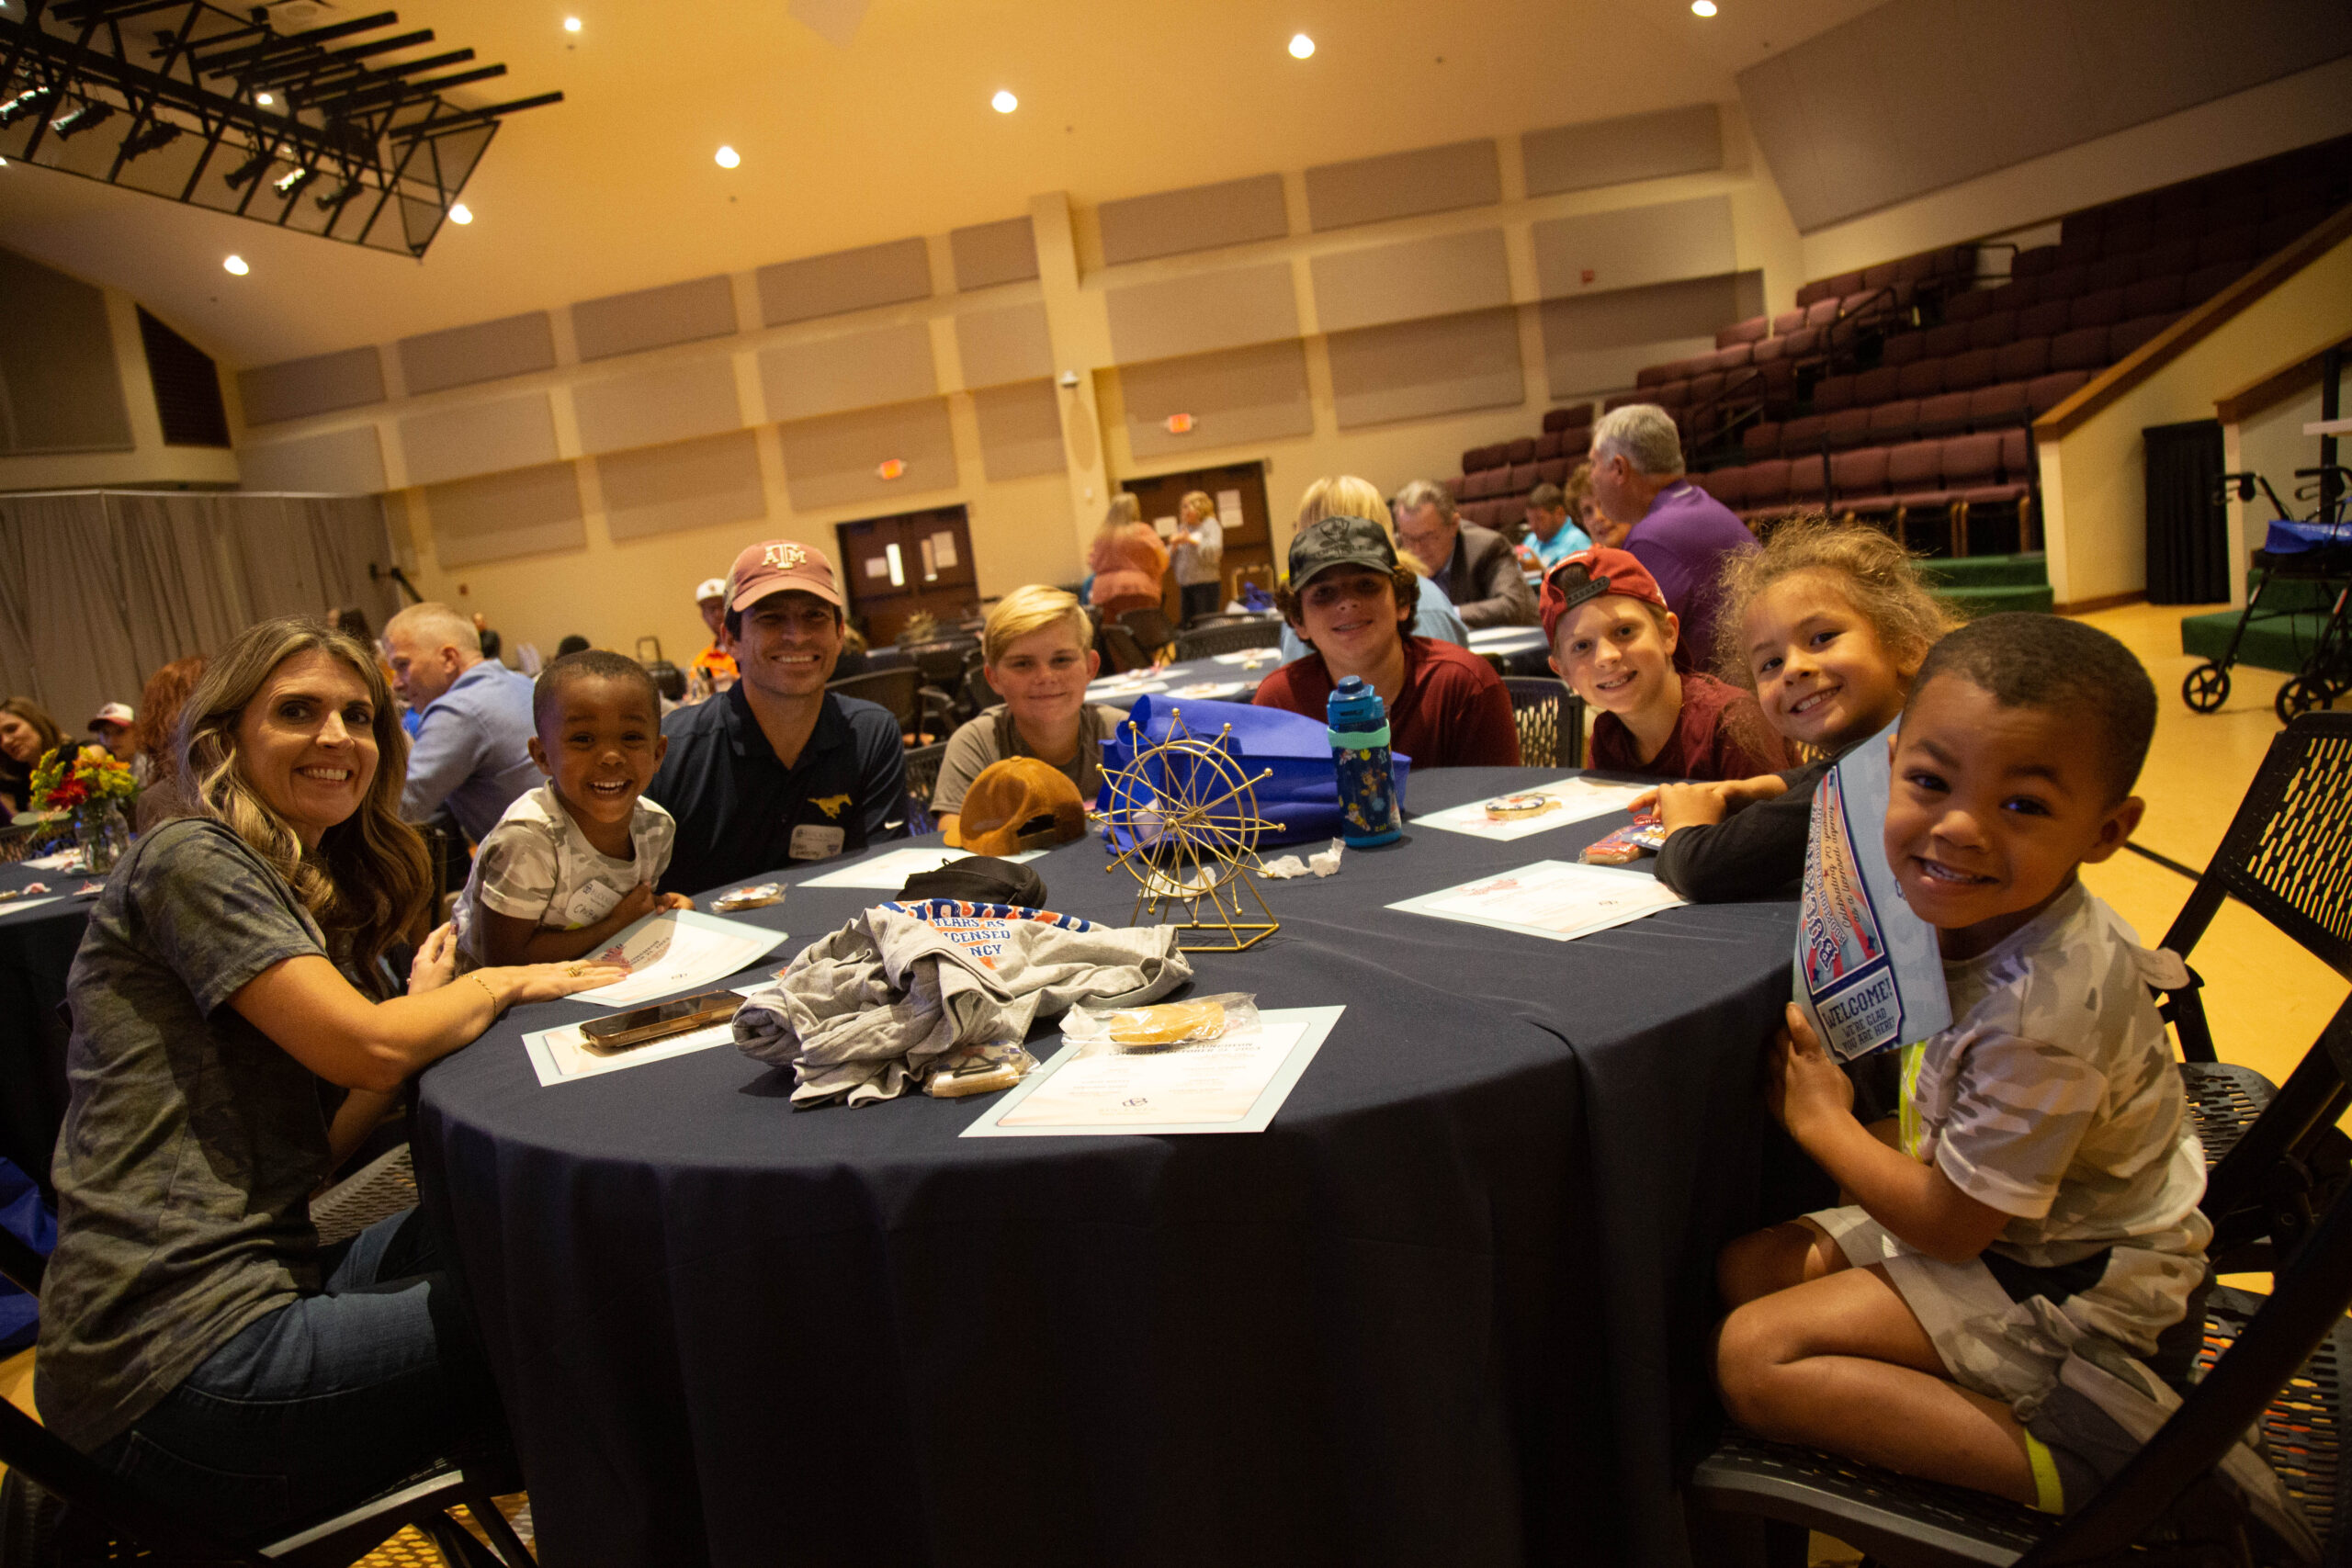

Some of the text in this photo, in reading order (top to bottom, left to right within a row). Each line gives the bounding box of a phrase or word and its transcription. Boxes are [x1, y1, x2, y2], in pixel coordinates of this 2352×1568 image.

[1833, 847, 1849, 892] licensed
[1820, 890, 1847, 945] ADOPTION
[1829, 864, 1852, 928] Celebrating
[933, 918, 1005, 928] YEARS AS
[1822, 977, 1893, 1029] WELCOME!
[1843, 1008, 1887, 1038] WE'RE GLAD
[1842, 1016, 1895, 1053] YOU ARE HERE!
